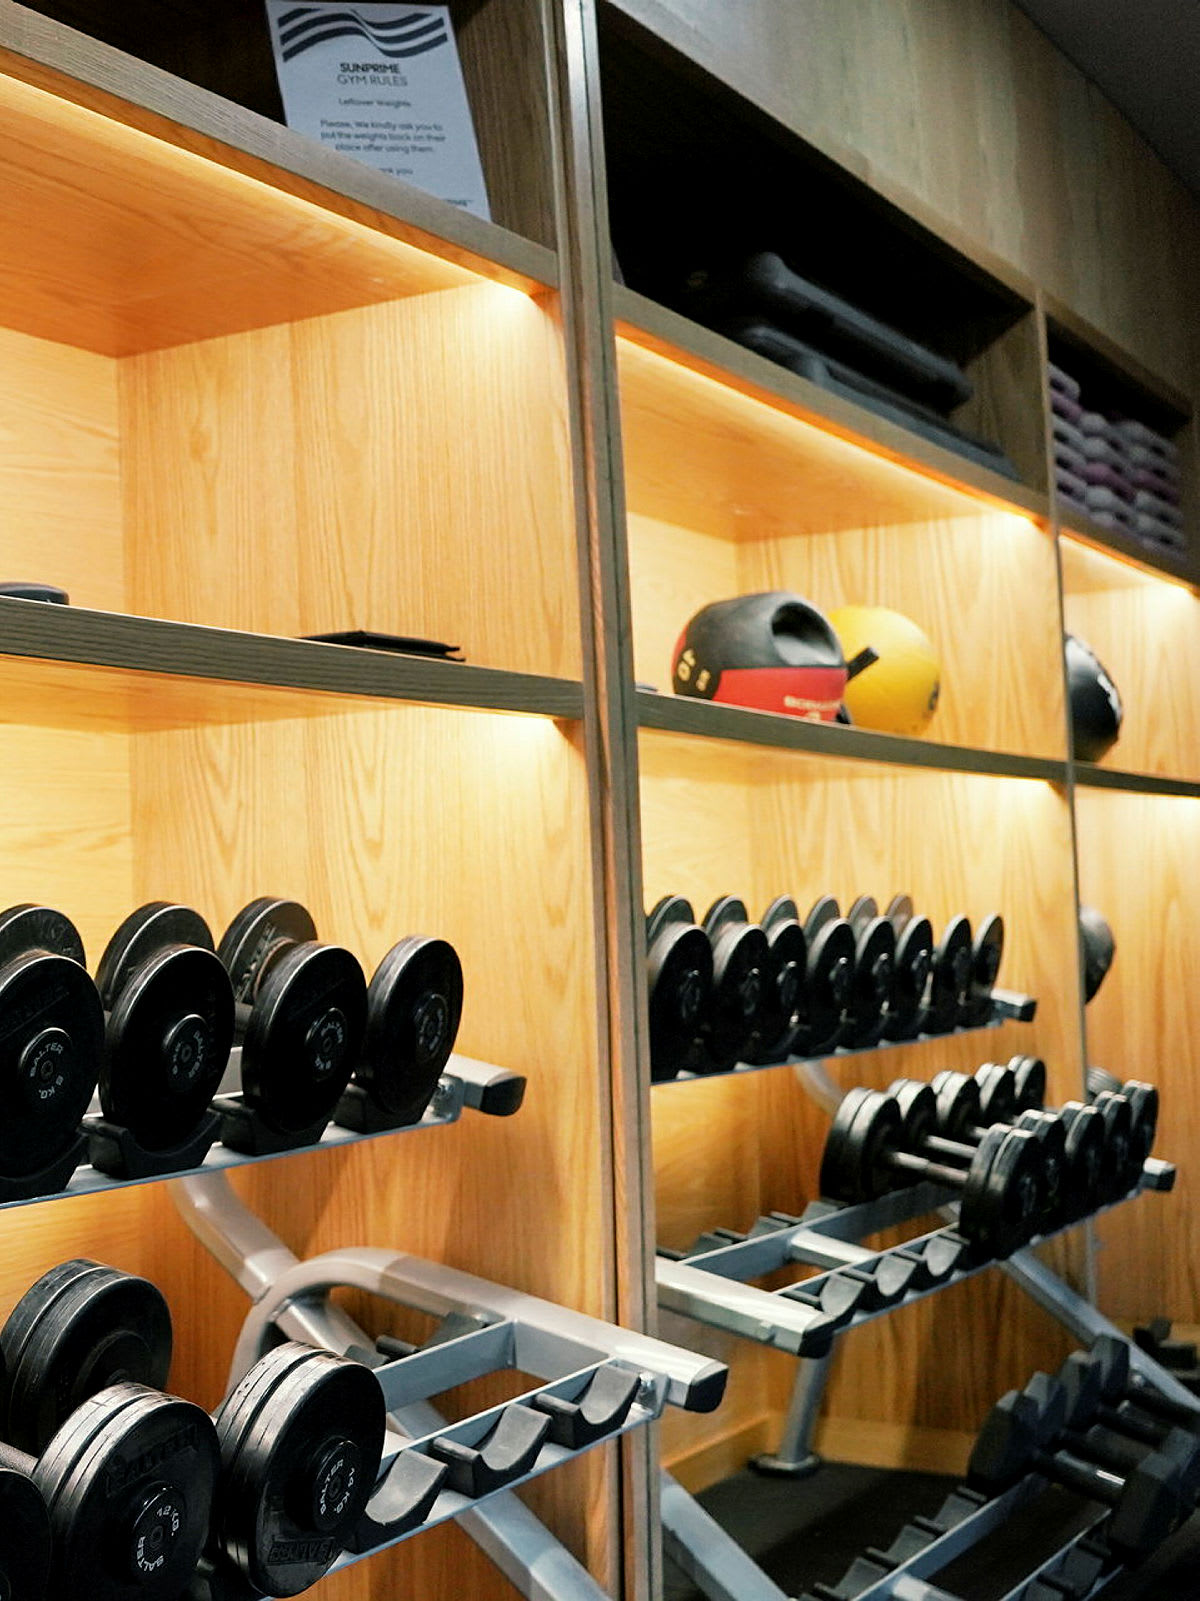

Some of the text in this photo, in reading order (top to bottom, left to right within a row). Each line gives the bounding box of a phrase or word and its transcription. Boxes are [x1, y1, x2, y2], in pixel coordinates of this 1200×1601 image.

[340, 64, 400, 73] SUNPRIME
[337, 75, 408, 87] GYM RULES
[320, 1458, 343, 1515] SALTER
[156, 1505, 171, 1517] 12
[136, 1536, 164, 1571] SALTER
